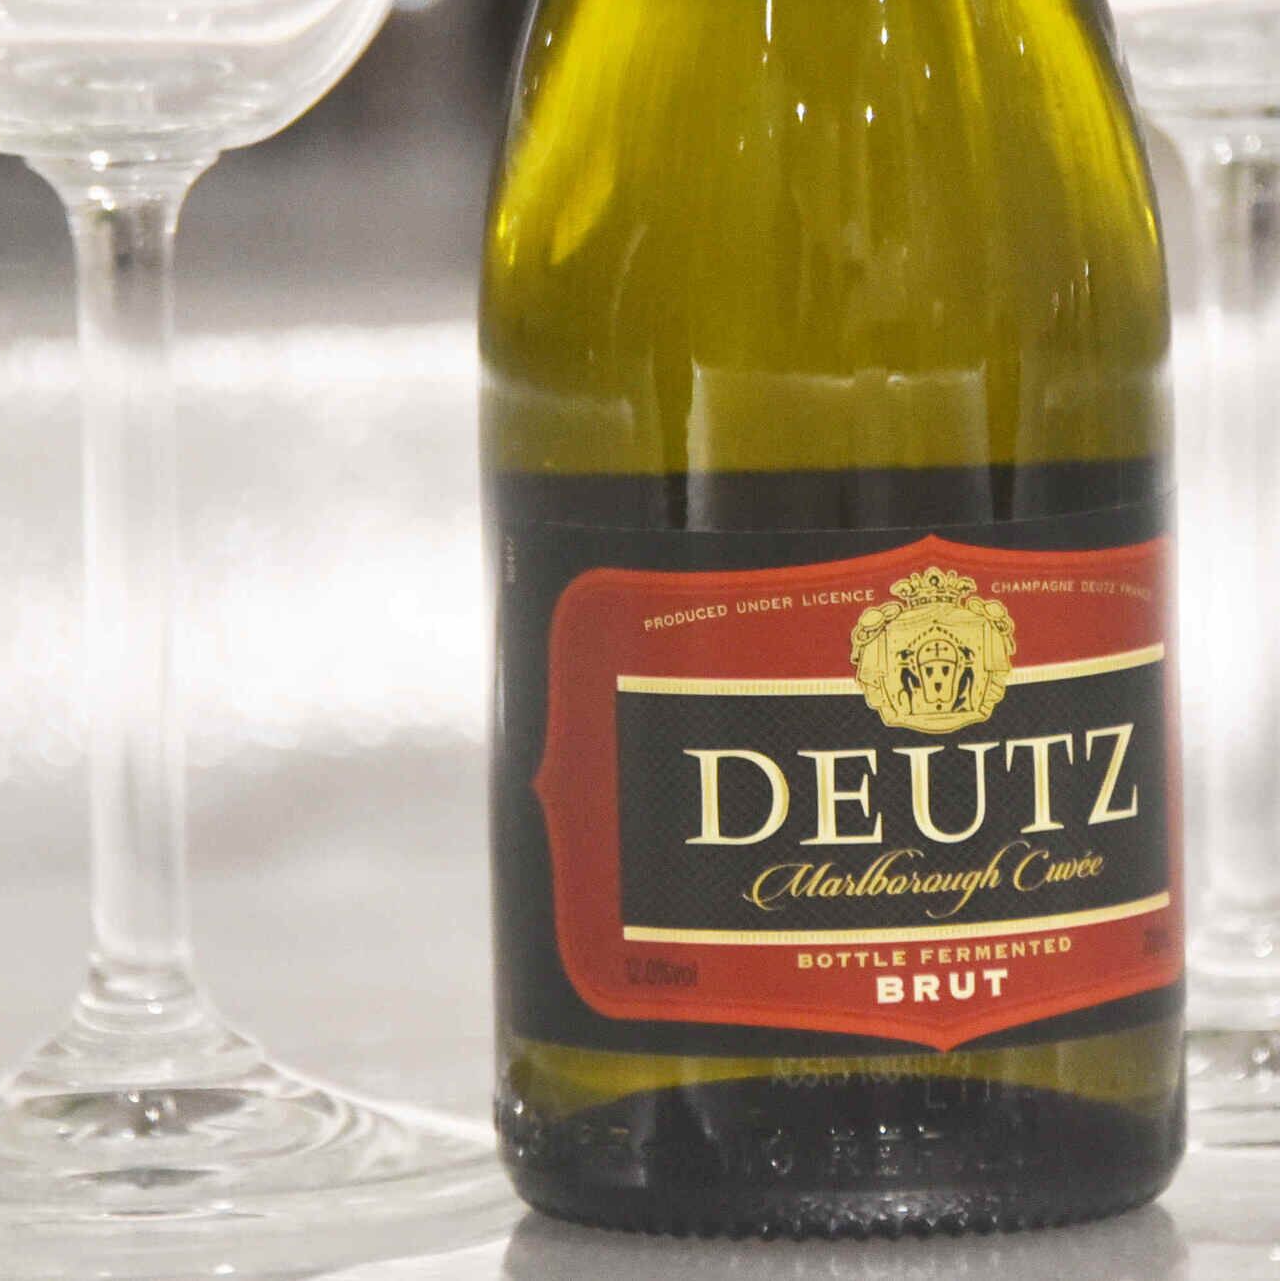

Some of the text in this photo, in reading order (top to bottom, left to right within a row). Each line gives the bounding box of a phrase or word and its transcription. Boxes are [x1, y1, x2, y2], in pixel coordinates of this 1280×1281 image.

[991, 580, 1074, 594] CHAMPAGNE
[1080, 581, 1115, 595] DEUTZ
[644, 589, 875, 632] PRODUCED UNDER LICENCE
[683, 723, 1139, 846] DEUTZ
[742, 840, 1105, 919] Marlborough Cuvée
[797, 936, 1072, 969] BOTTLE FERMENTED
[876, 968, 1009, 1005] BRUT
